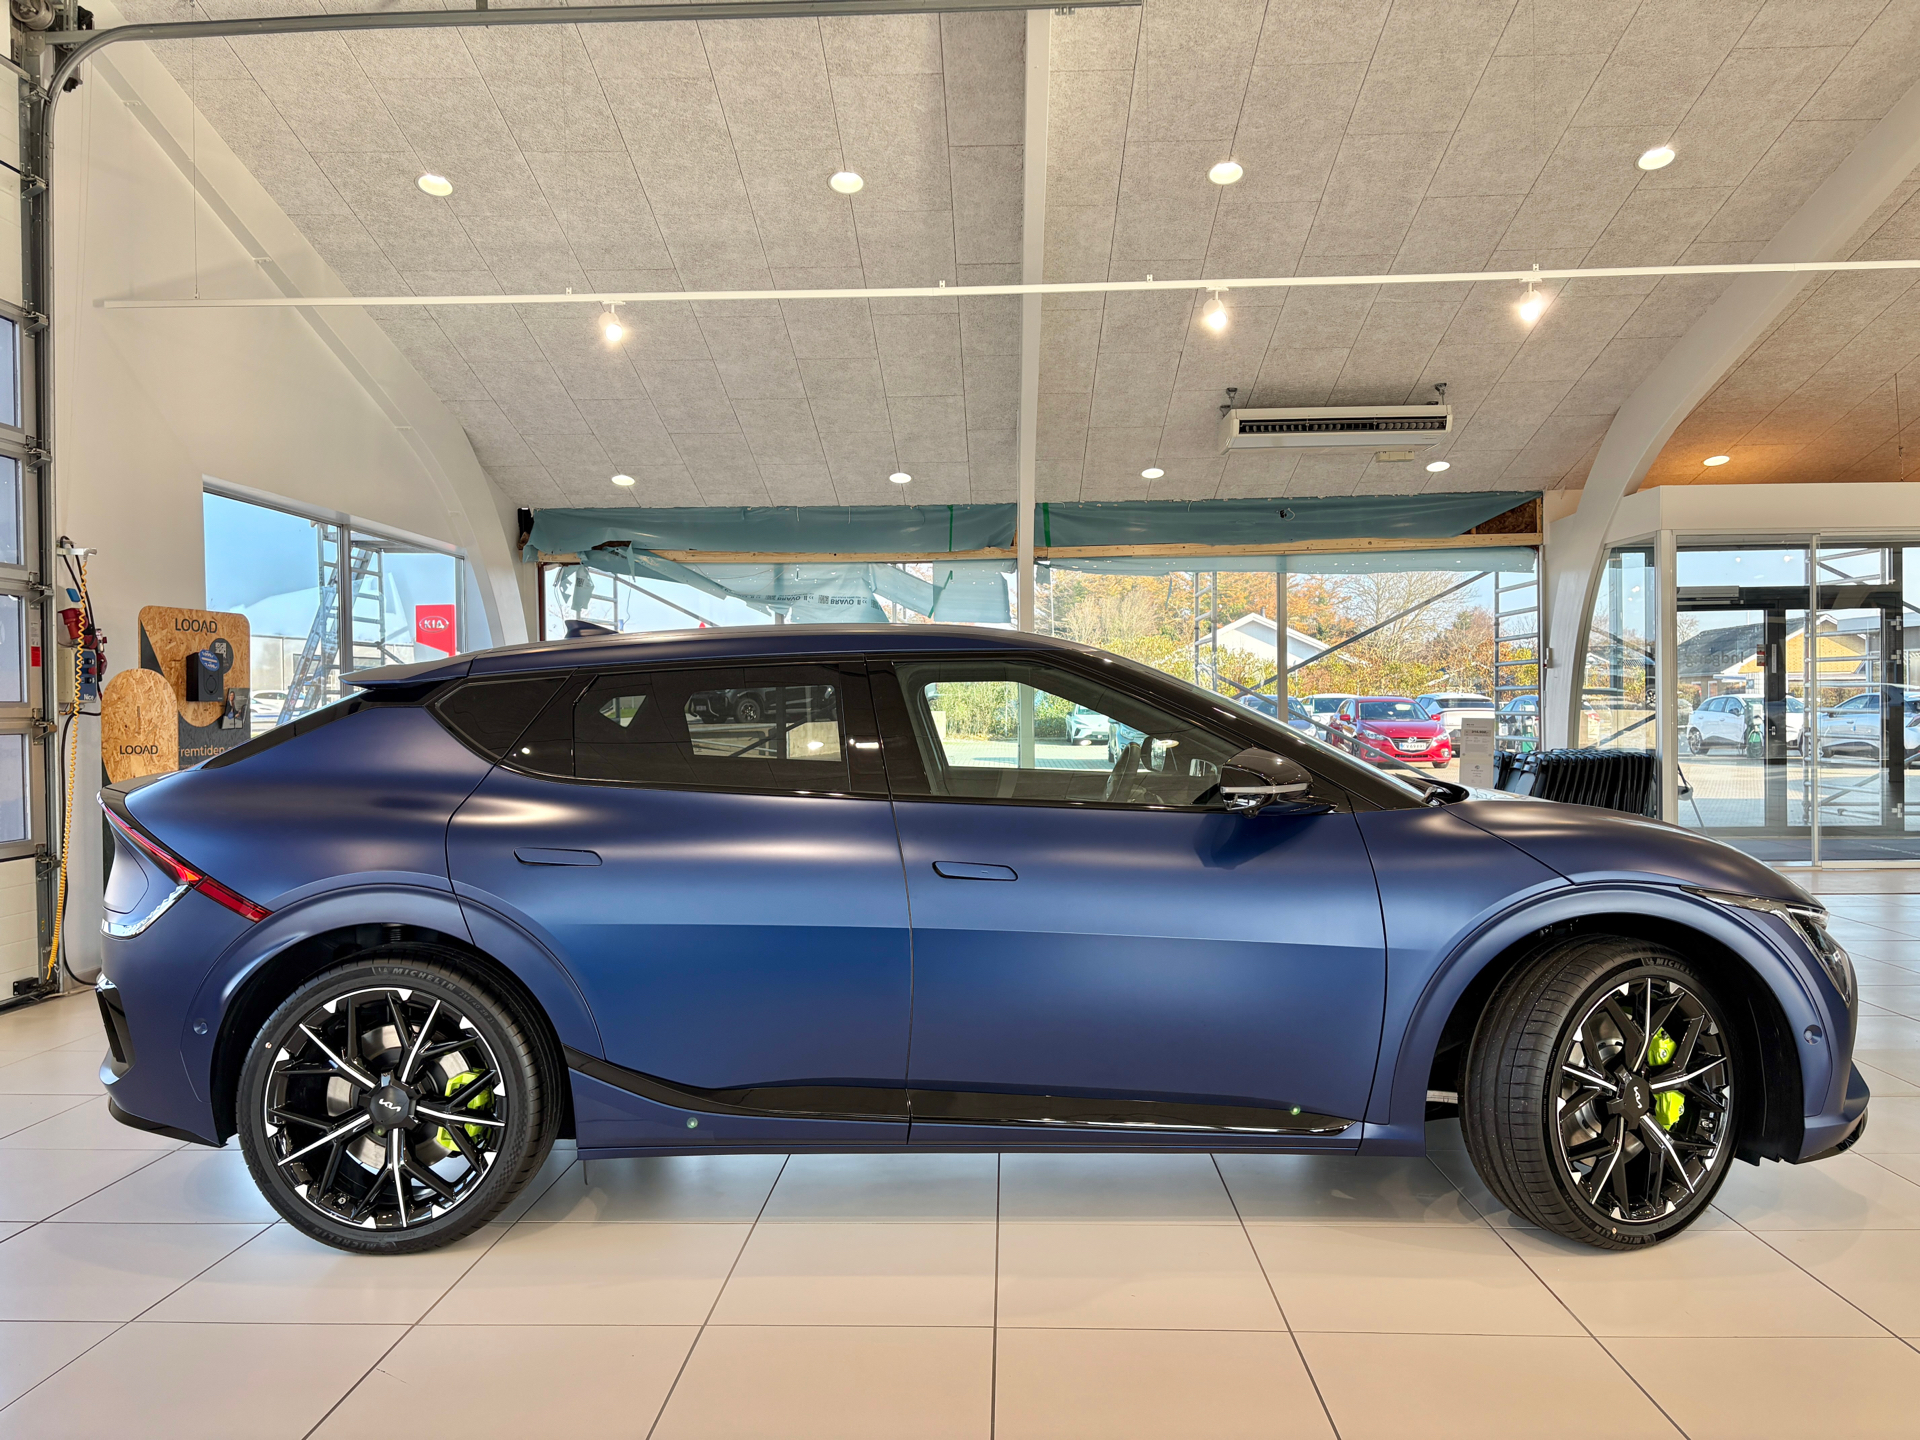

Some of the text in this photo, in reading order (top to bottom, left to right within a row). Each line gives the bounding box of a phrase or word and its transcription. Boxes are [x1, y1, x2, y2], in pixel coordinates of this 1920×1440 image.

[175, 618, 218, 633] LOOAD
[424, 620, 445, 629] KIA
[120, 745, 159, 755] LOOAD
[392, 967, 456, 991] MICHELIN
[312, 1227, 377, 1249] MICHELIN
[1594, 1225, 1643, 1244] MICHELIN
